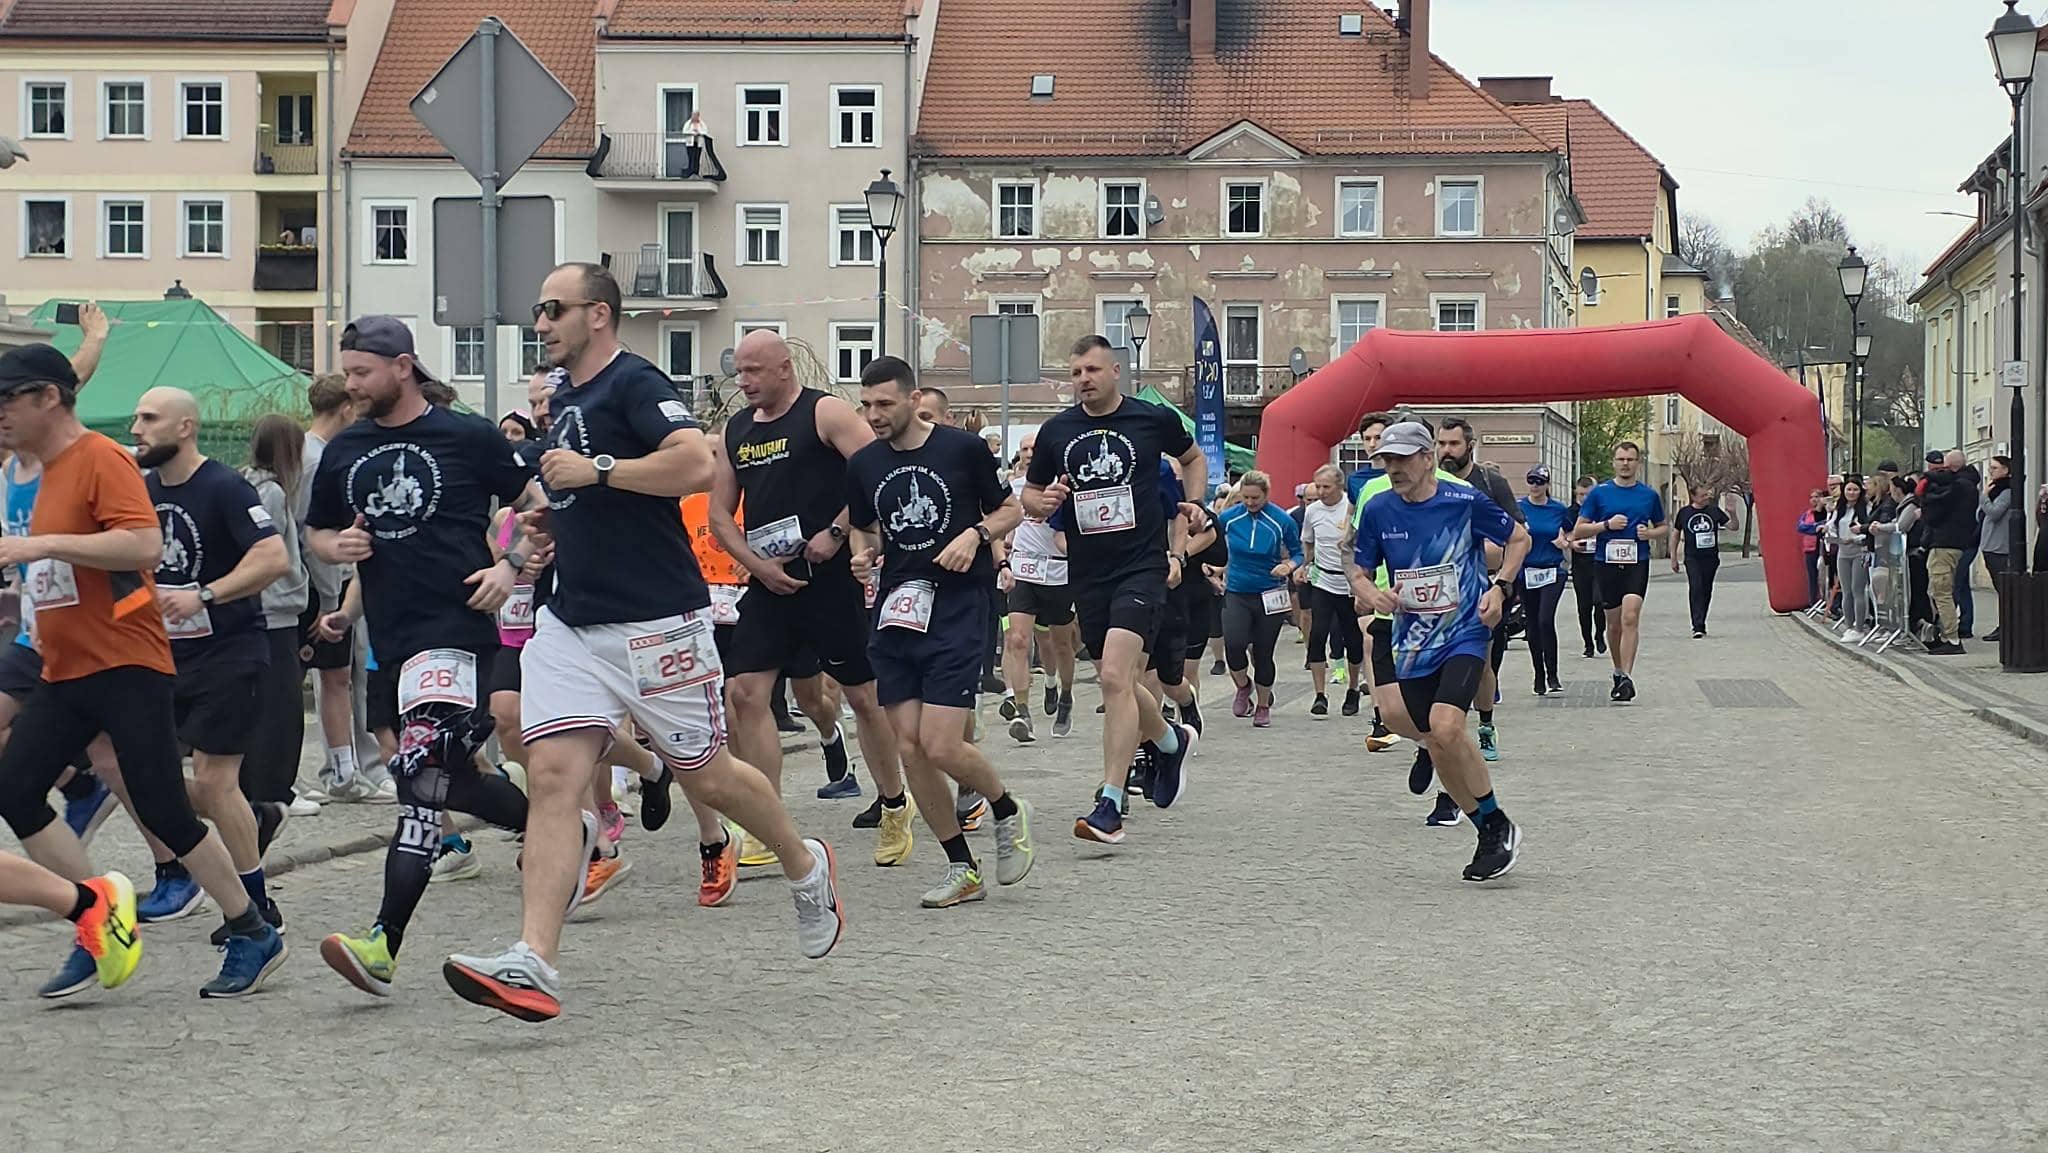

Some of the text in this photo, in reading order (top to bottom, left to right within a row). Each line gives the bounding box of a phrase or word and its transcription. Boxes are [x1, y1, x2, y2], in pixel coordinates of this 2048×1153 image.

[1098, 505, 1111, 521] 2
[1414, 584, 1439, 603] 57
[510, 602, 529, 617] 47
[889, 596, 913, 614] 43
[659, 649, 695, 678] 25
[419, 669, 453, 689] 26
